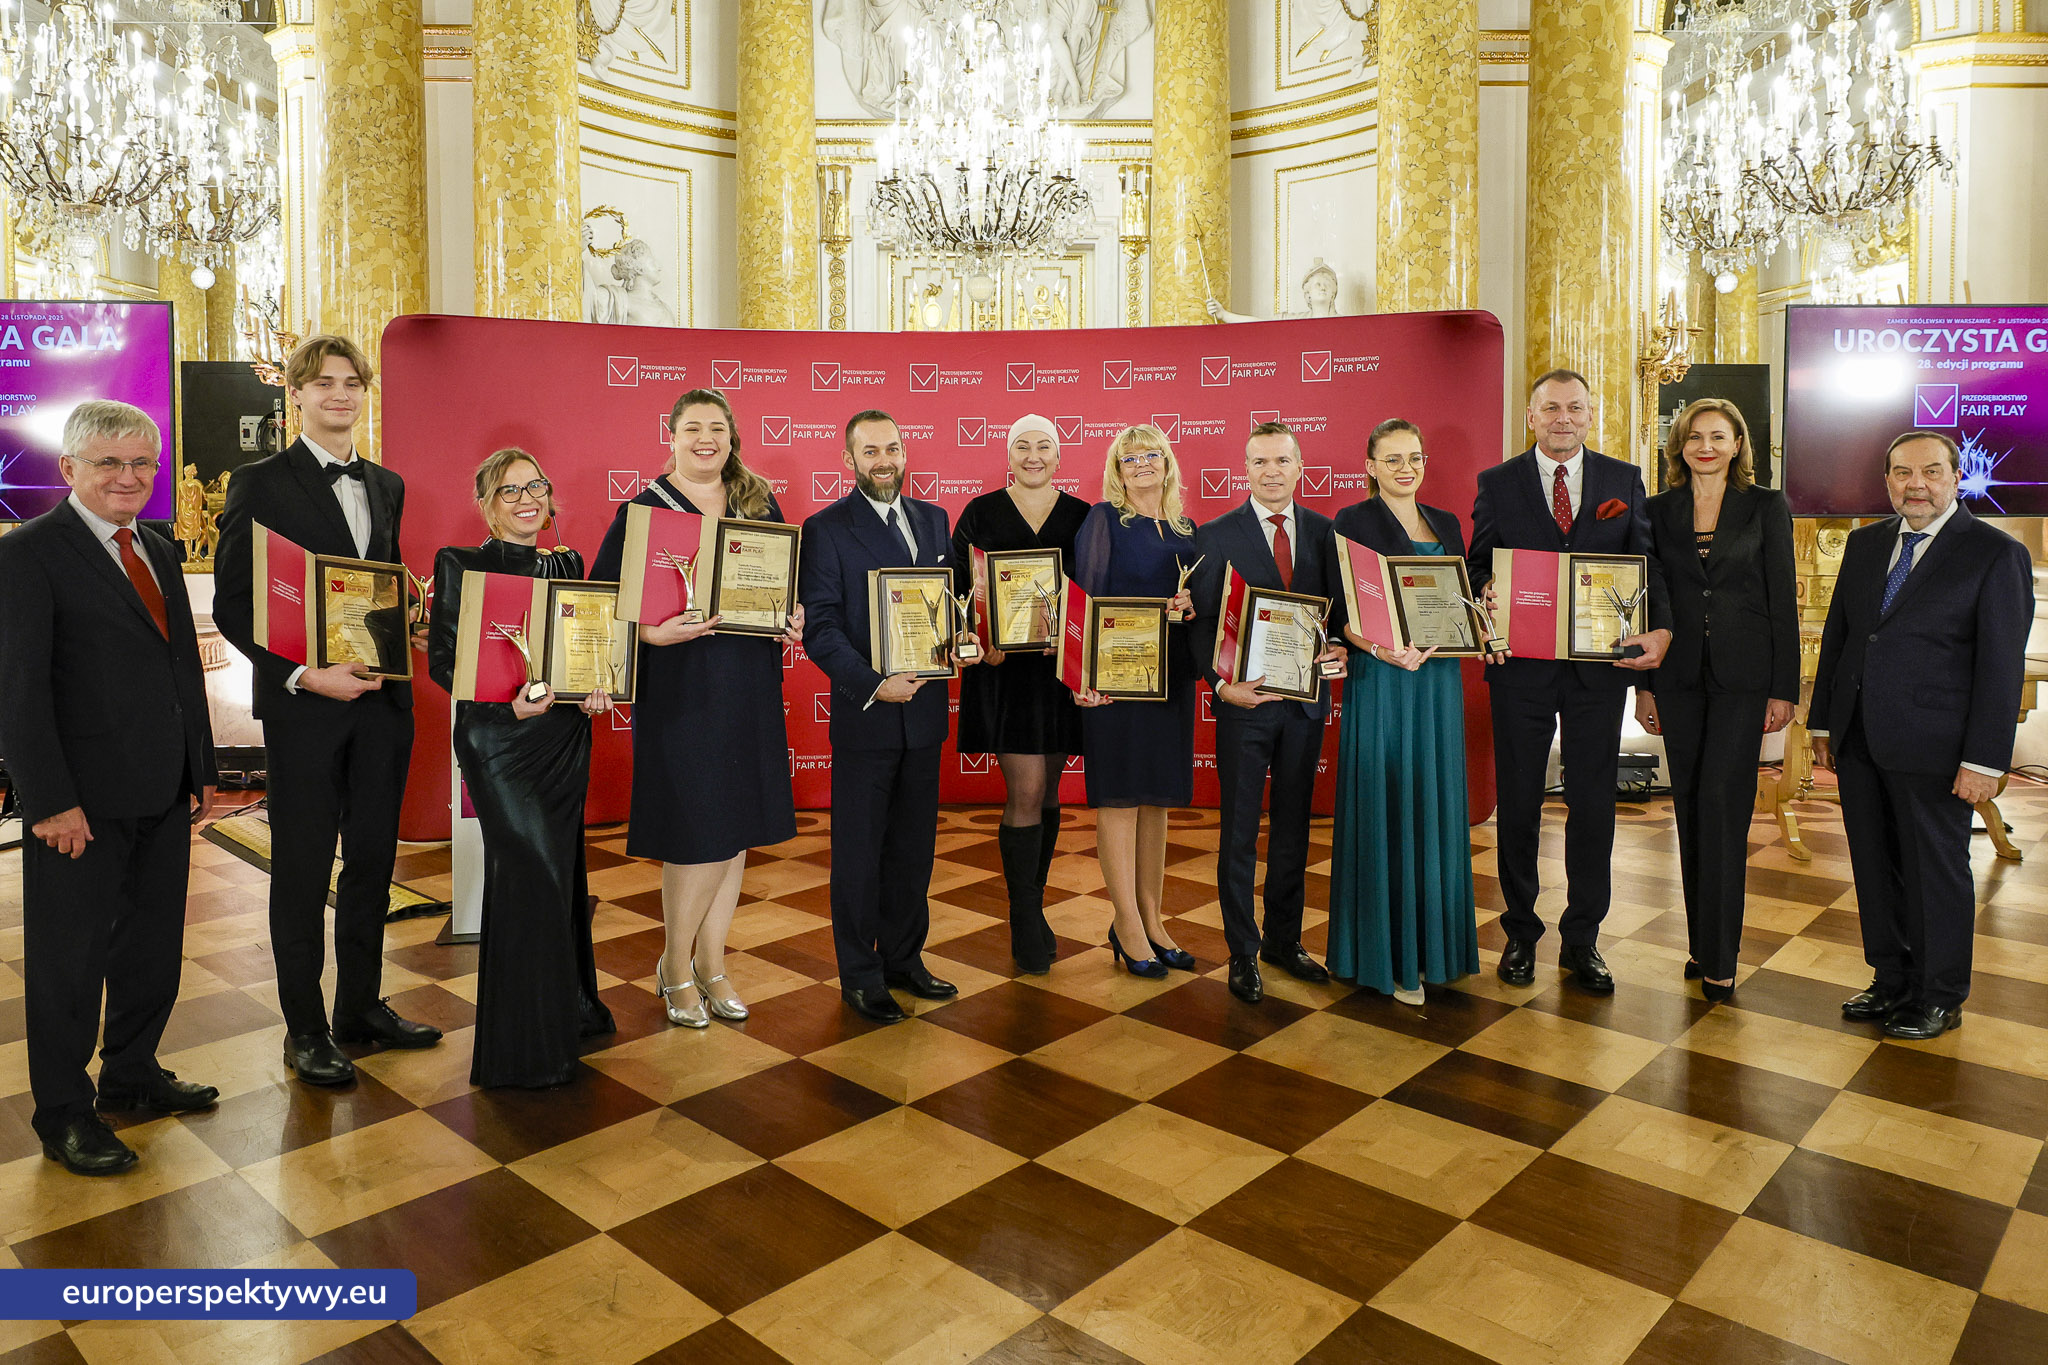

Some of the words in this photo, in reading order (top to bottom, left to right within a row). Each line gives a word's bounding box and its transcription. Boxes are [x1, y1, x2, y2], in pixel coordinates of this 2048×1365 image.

[0, 325, 24, 350] A
[32, 325, 122, 350] GALA
[1833, 328, 2019, 353] UROCZYSTA
[2026, 328, 2048, 353] G
[0, 359, 30, 367] ramu
[1334, 364, 1354, 373] FAIR
[1356, 363, 1380, 372] PLAY
[1918, 359, 1934, 368] 28.
[1936, 359, 1968, 370] edycji
[1971, 361, 2024, 370] programu
[1134, 374, 1153, 382] FAIR
[1155, 373, 1177, 381] PLAY
[1232, 369, 1251, 378] FAIR
[1254, 368, 1276, 376] PLAY
[1, 405, 36, 416] PLAY
[1960, 405, 1990, 416] FAIR
[1993, 404, 2027, 416] PLAY
[1182, 427, 1201, 435] FAIR
[1334, 481, 1354, 489] FAIR
